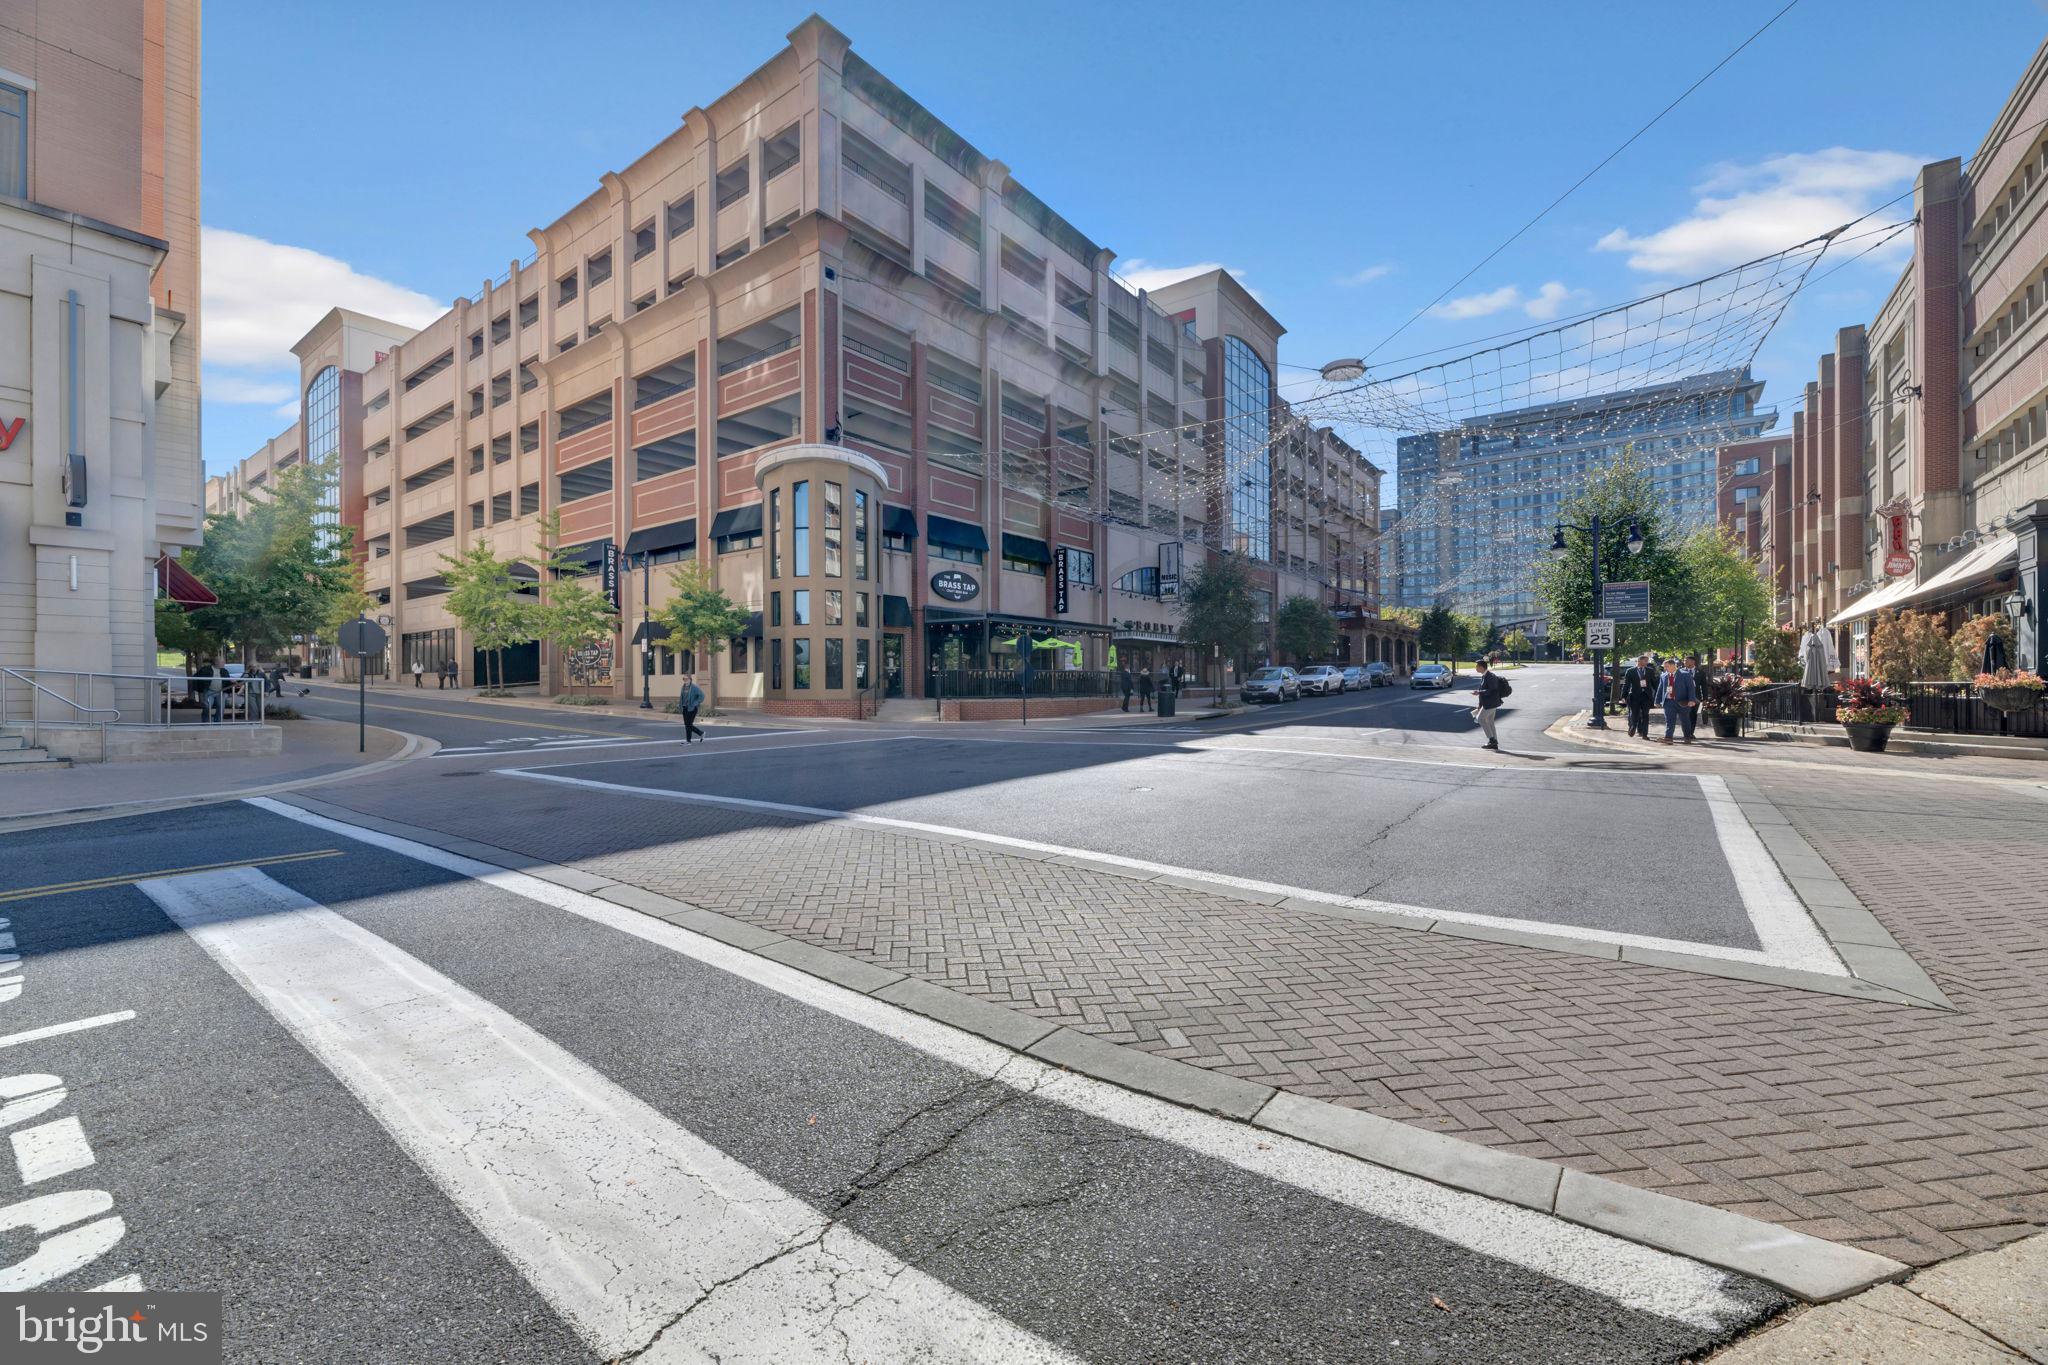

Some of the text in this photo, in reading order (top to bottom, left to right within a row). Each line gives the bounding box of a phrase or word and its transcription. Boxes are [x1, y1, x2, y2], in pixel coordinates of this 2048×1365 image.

[938, 579, 976, 591] BRASS TAP
[1590, 634, 1611, 645] 25
